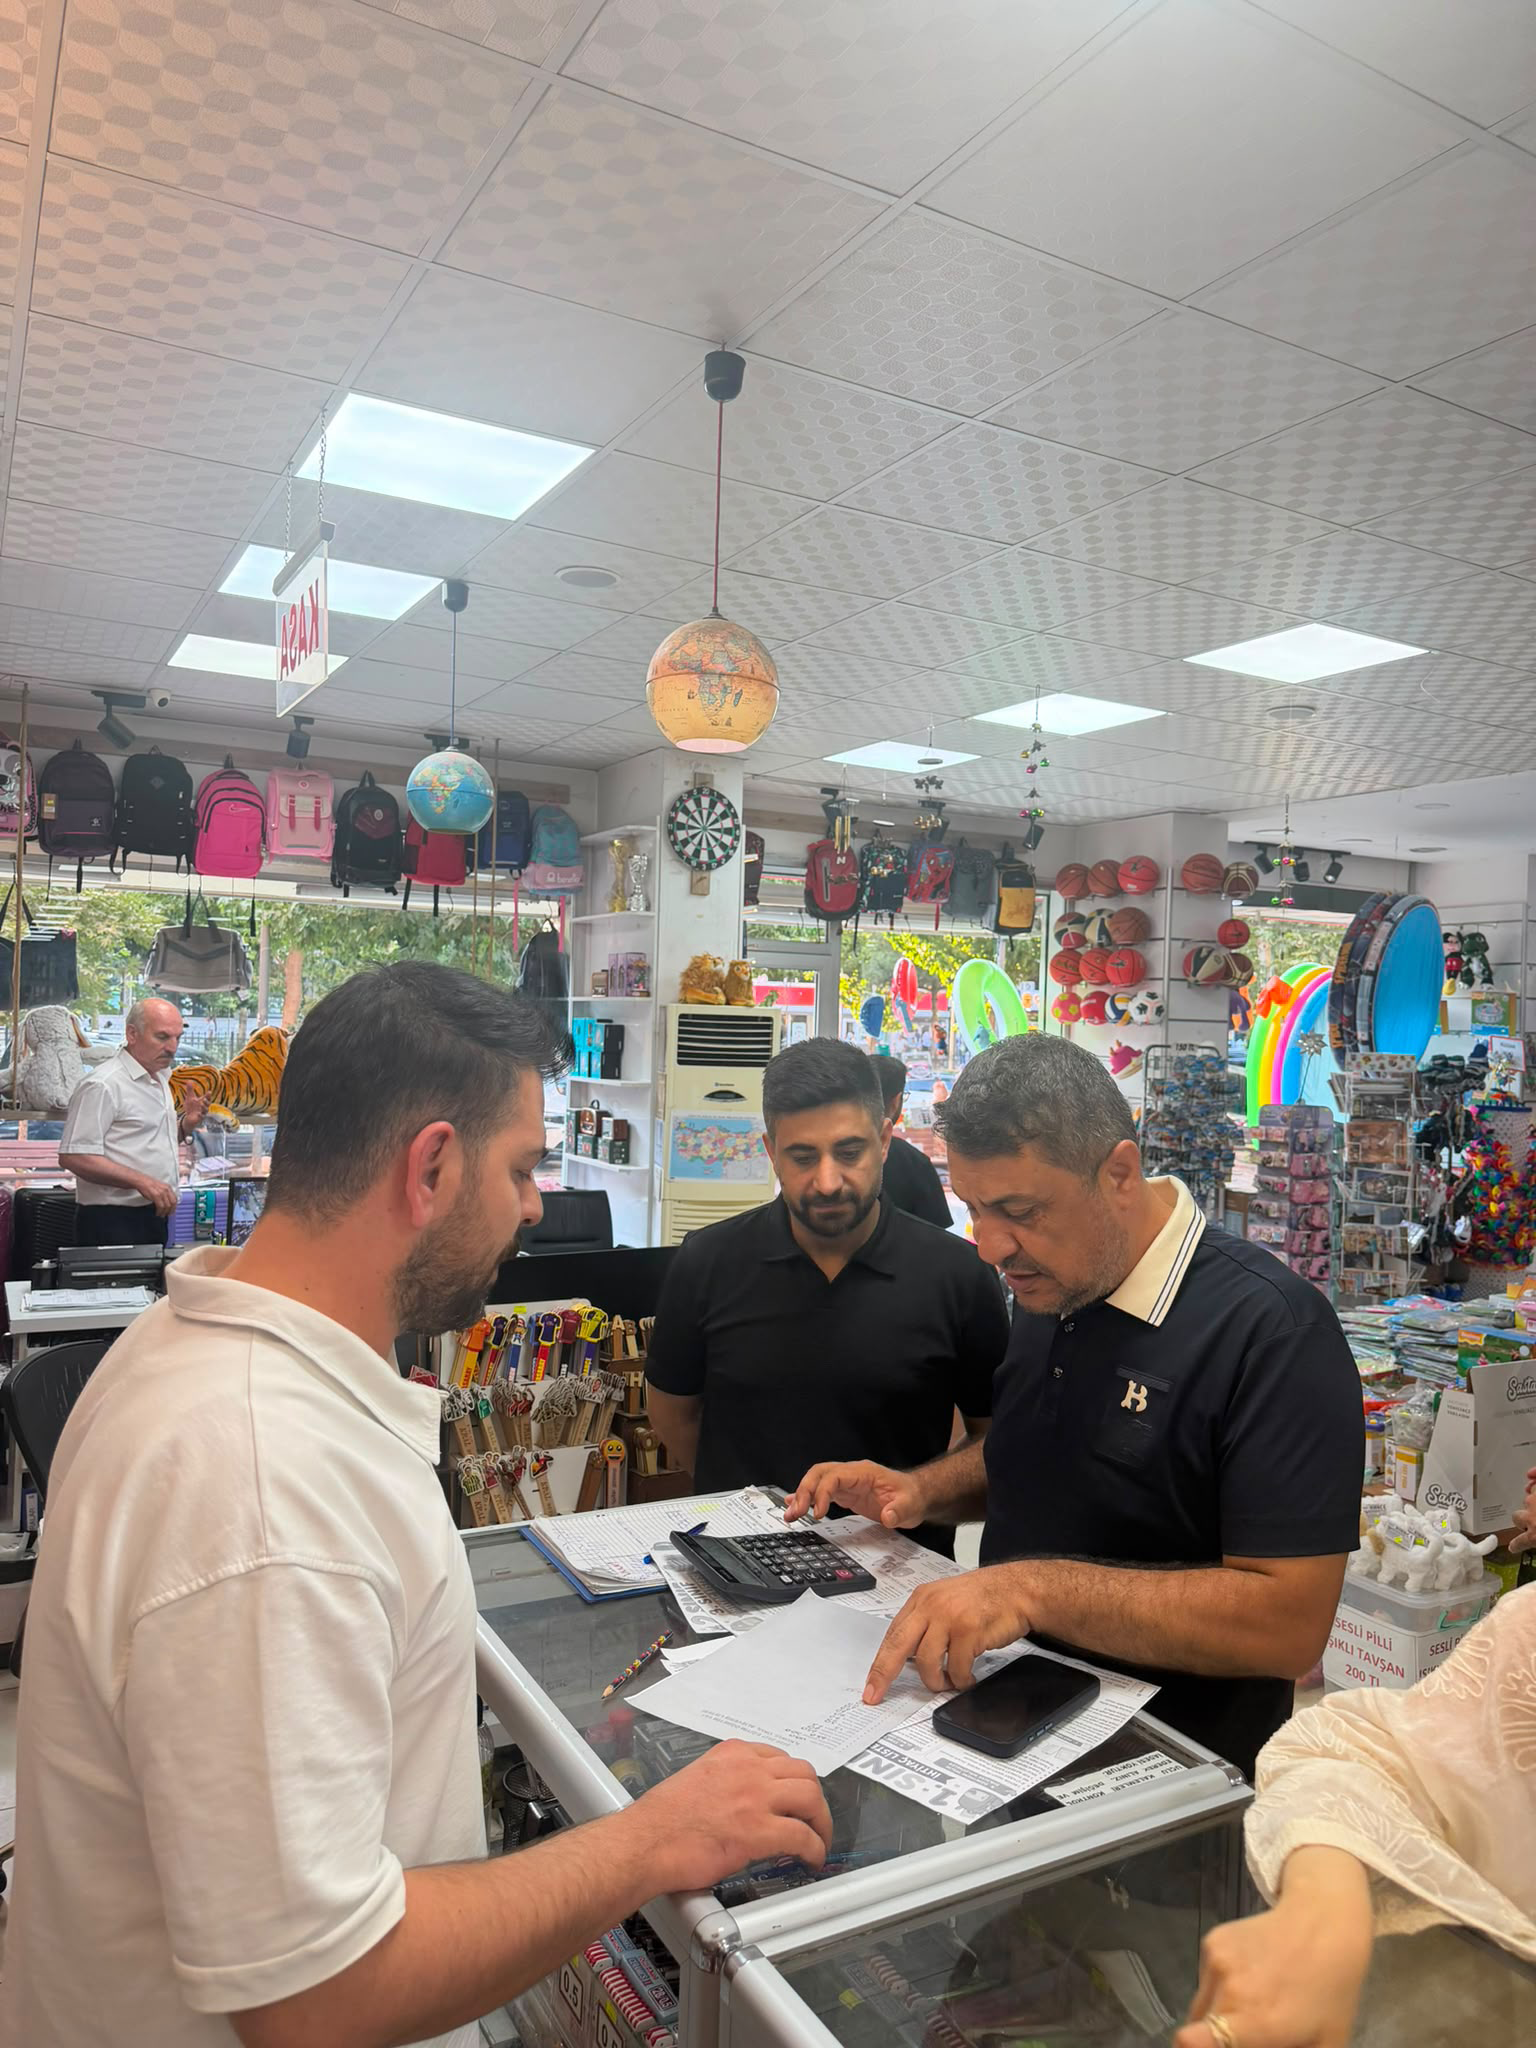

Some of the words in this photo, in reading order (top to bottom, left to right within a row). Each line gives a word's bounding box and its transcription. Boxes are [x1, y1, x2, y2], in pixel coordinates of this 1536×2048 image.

[1425, 1483, 1468, 1512] Sasta
[1334, 1617, 1363, 1639] SESLİ
[1366, 1630, 1392, 1651] PİLLİ
[1327, 1635, 1354, 1656] ŞIKLI
[1357, 1647, 1405, 1678] TAVŞAN
[1429, 1637, 1453, 1656] SESLİ
[1345, 1664, 1366, 1682] 200
[869, 1742, 900, 1760] LİSTE
[898, 1756, 942, 1779] İHTİYAÇ
[1066, 1791, 1106, 1806] KONTROL
[564, 1970, 578, 2007] 0.5
